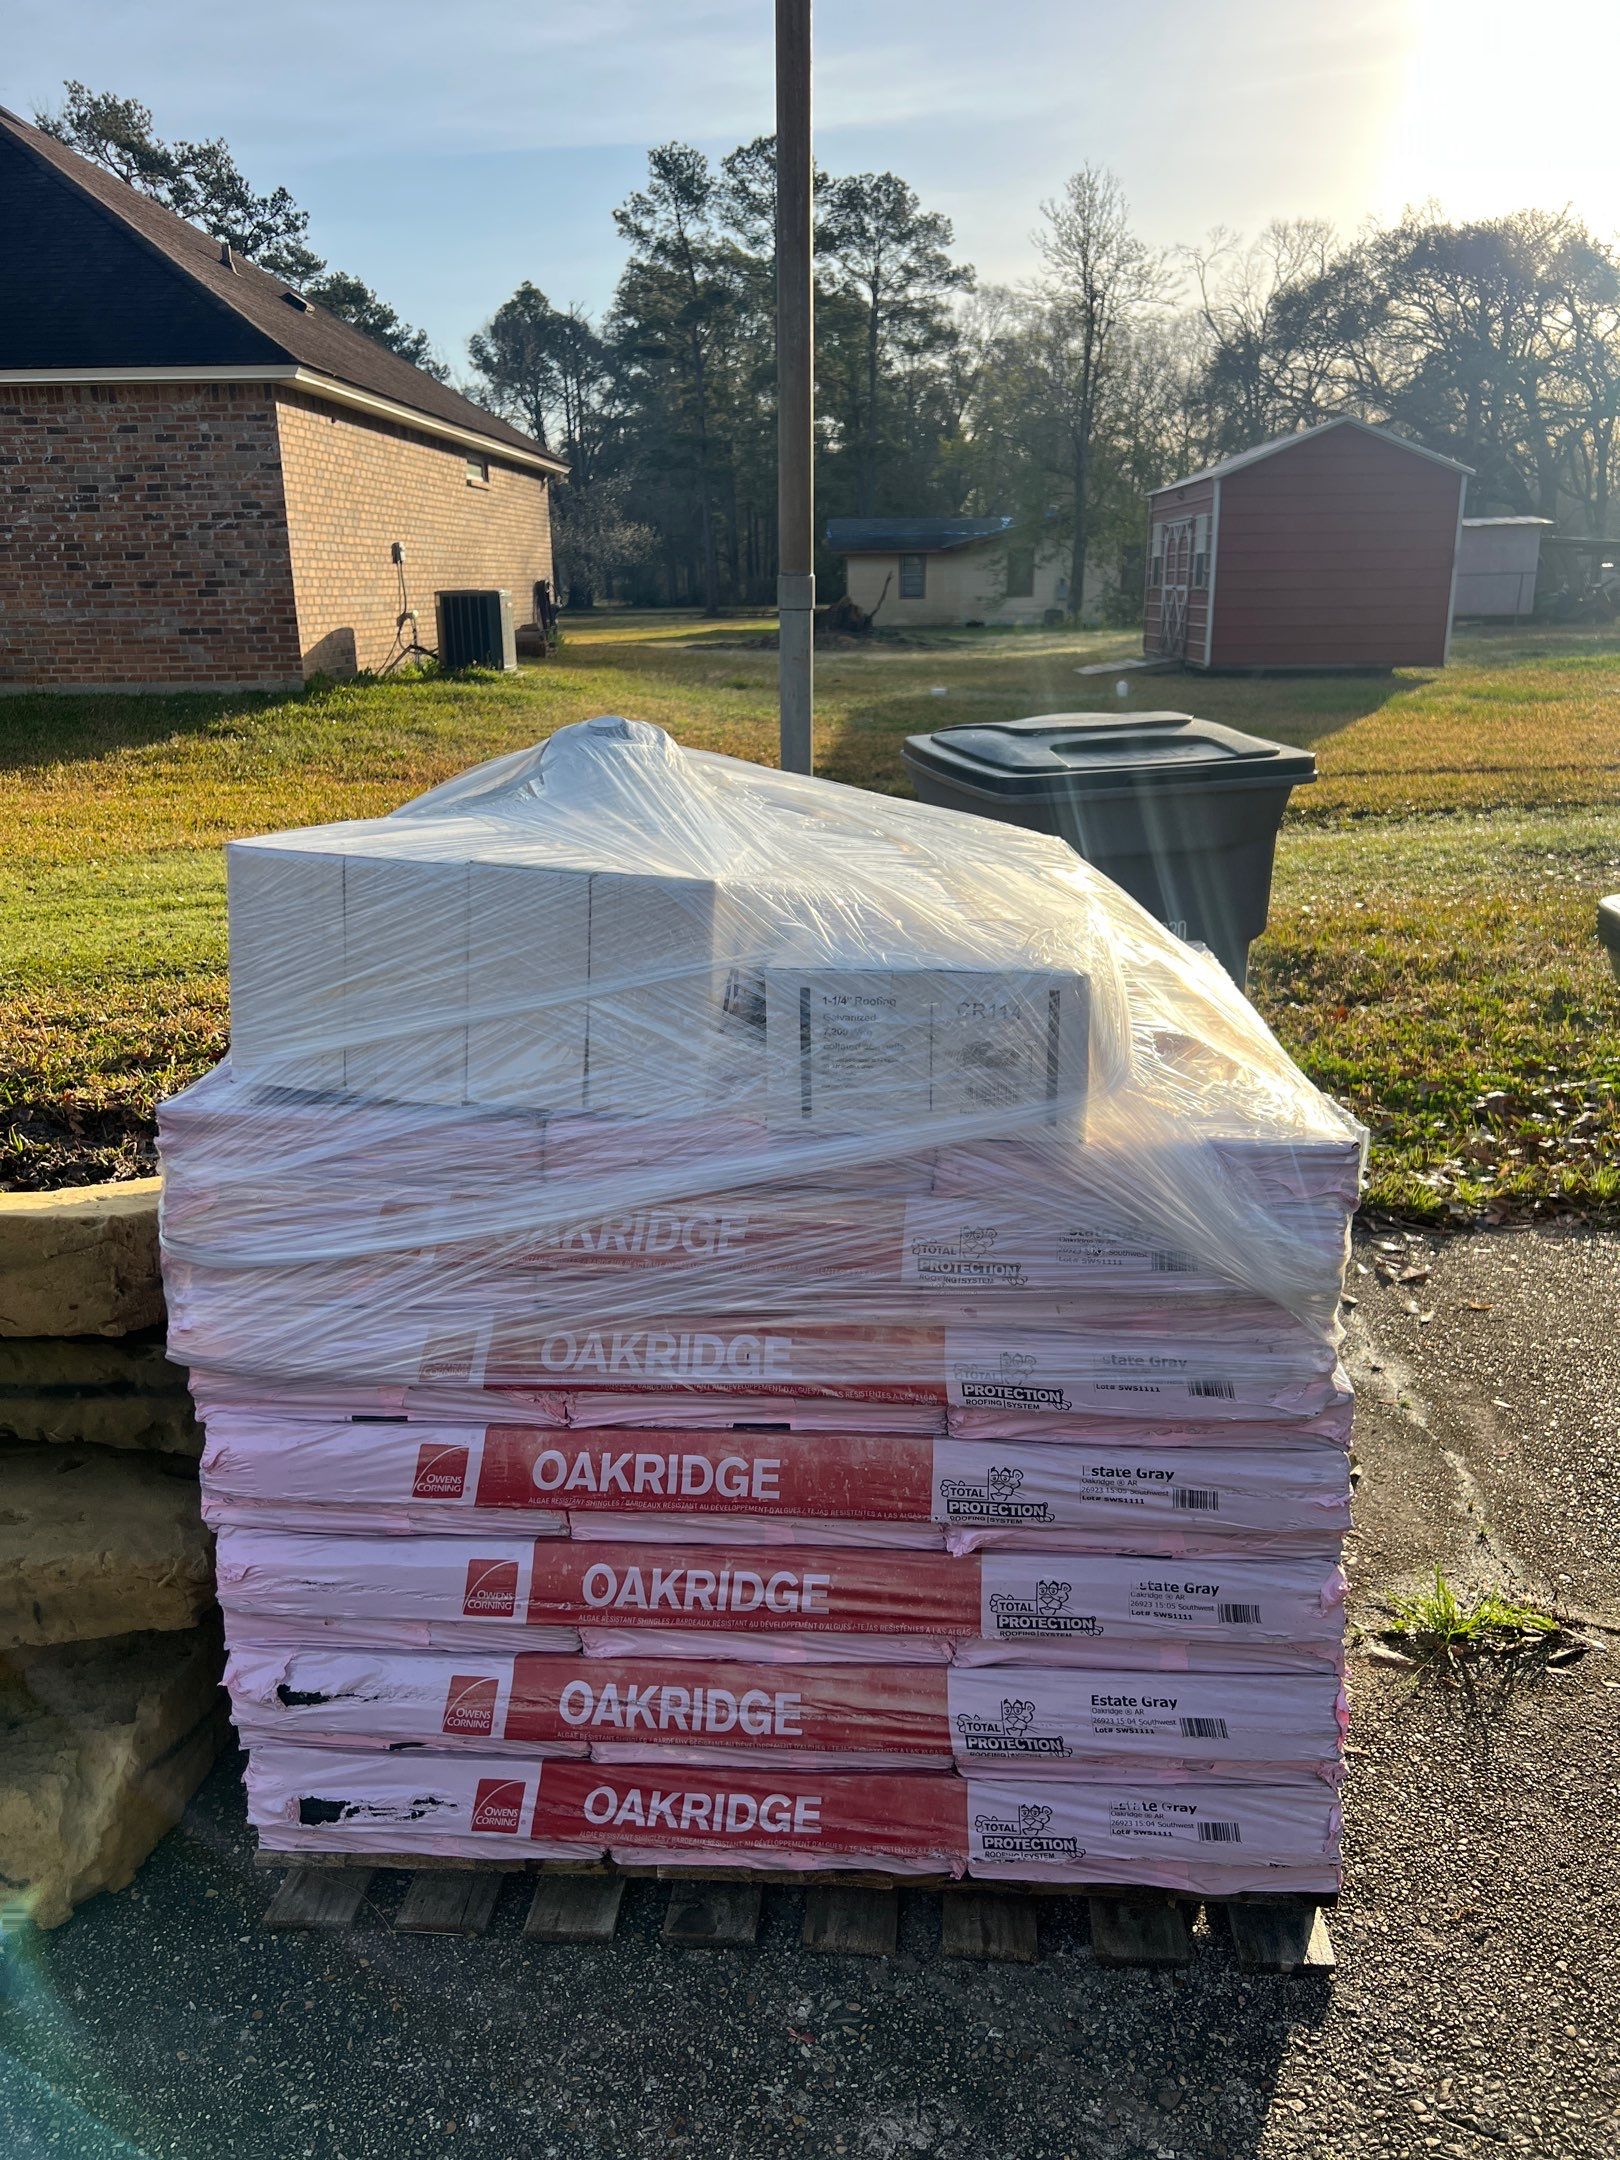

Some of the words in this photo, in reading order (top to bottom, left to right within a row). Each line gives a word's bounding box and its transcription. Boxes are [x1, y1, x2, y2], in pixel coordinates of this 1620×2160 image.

[920, 1245, 957, 1256] TOTAL
[920, 1259, 1018, 1277] PROTECTION
[541, 1330, 793, 1377] OAKRIDGE
[1149, 1356, 1188, 1369] Gray
[964, 1371, 998, 1381] TOTAL
[963, 1384, 1061, 1403] PROTECTION
[966, 1398, 1002, 1406] ROOFING
[1006, 1401, 1040, 1410] SYSTEM
[426, 1474, 462, 1485] OWENS
[532, 1449, 781, 1500] OAKRIDGE
[1136, 1467, 1175, 1482] Gray
[416, 1483, 461, 1492] CORNING
[949, 1487, 985, 1498] TOTAL
[550, 1497, 585, 1505] RESISTANT
[585, 1499, 620, 1507] SHINGLES
[948, 1501, 1045, 1516] PROTECTION
[989, 1517, 1023, 1525] SYSTEM
[582, 1562, 830, 1614] OAKRIDGE
[1183, 1582, 1220, 1597] Gray
[477, 1590, 514, 1601] OWENS
[467, 1599, 513, 1610] CORNING
[999, 1602, 1034, 1612] TOTAL
[1130, 1600, 1153, 1608] 26923
[1155, 1601, 1176, 1609] 15:05
[1178, 1603, 1215, 1612] Southwest
[578, 1614, 601, 1622] ALGAE
[601, 1615, 637, 1624] RESISTANT
[637, 1616, 671, 1625] SHINGLES
[749, 1620, 759, 1628] AU
[1153, 1611, 1193, 1620] SWS1111
[999, 1616, 1093, 1630] PROTECTION
[559, 1679, 802, 1736] OAKRIDGE
[1091, 1694, 1138, 1707] Estate
[1141, 1695, 1178, 1710] Gray
[456, 1707, 491, 1719] OWENS
[1091, 1707, 1123, 1716] Oakridge
[446, 1716, 490, 1728] CORNING
[967, 1722, 1001, 1732] TOTAL
[1138, 1718, 1177, 1726] Southwest
[1094, 1726, 1114, 1734] Lot#
[1115, 1727, 1155, 1735] SWS1111
[968, 1736, 1062, 1751] PROTECTION
[484, 1806, 519, 1817] OWENS
[583, 1785, 822, 1834] OAKRIDGE
[1161, 1802, 1198, 1814] Gray
[475, 1815, 517, 1827] CORNING
[1110, 1811, 1142, 1819] Oakridge
[985, 1823, 1017, 1833] TOTAL
[1111, 1819, 1133, 1827] 26923
[1157, 1821, 1195, 1829] Southwest
[1133, 1829, 1173, 1837] SWS1111
[984, 1837, 1075, 1851] PROTECTION
